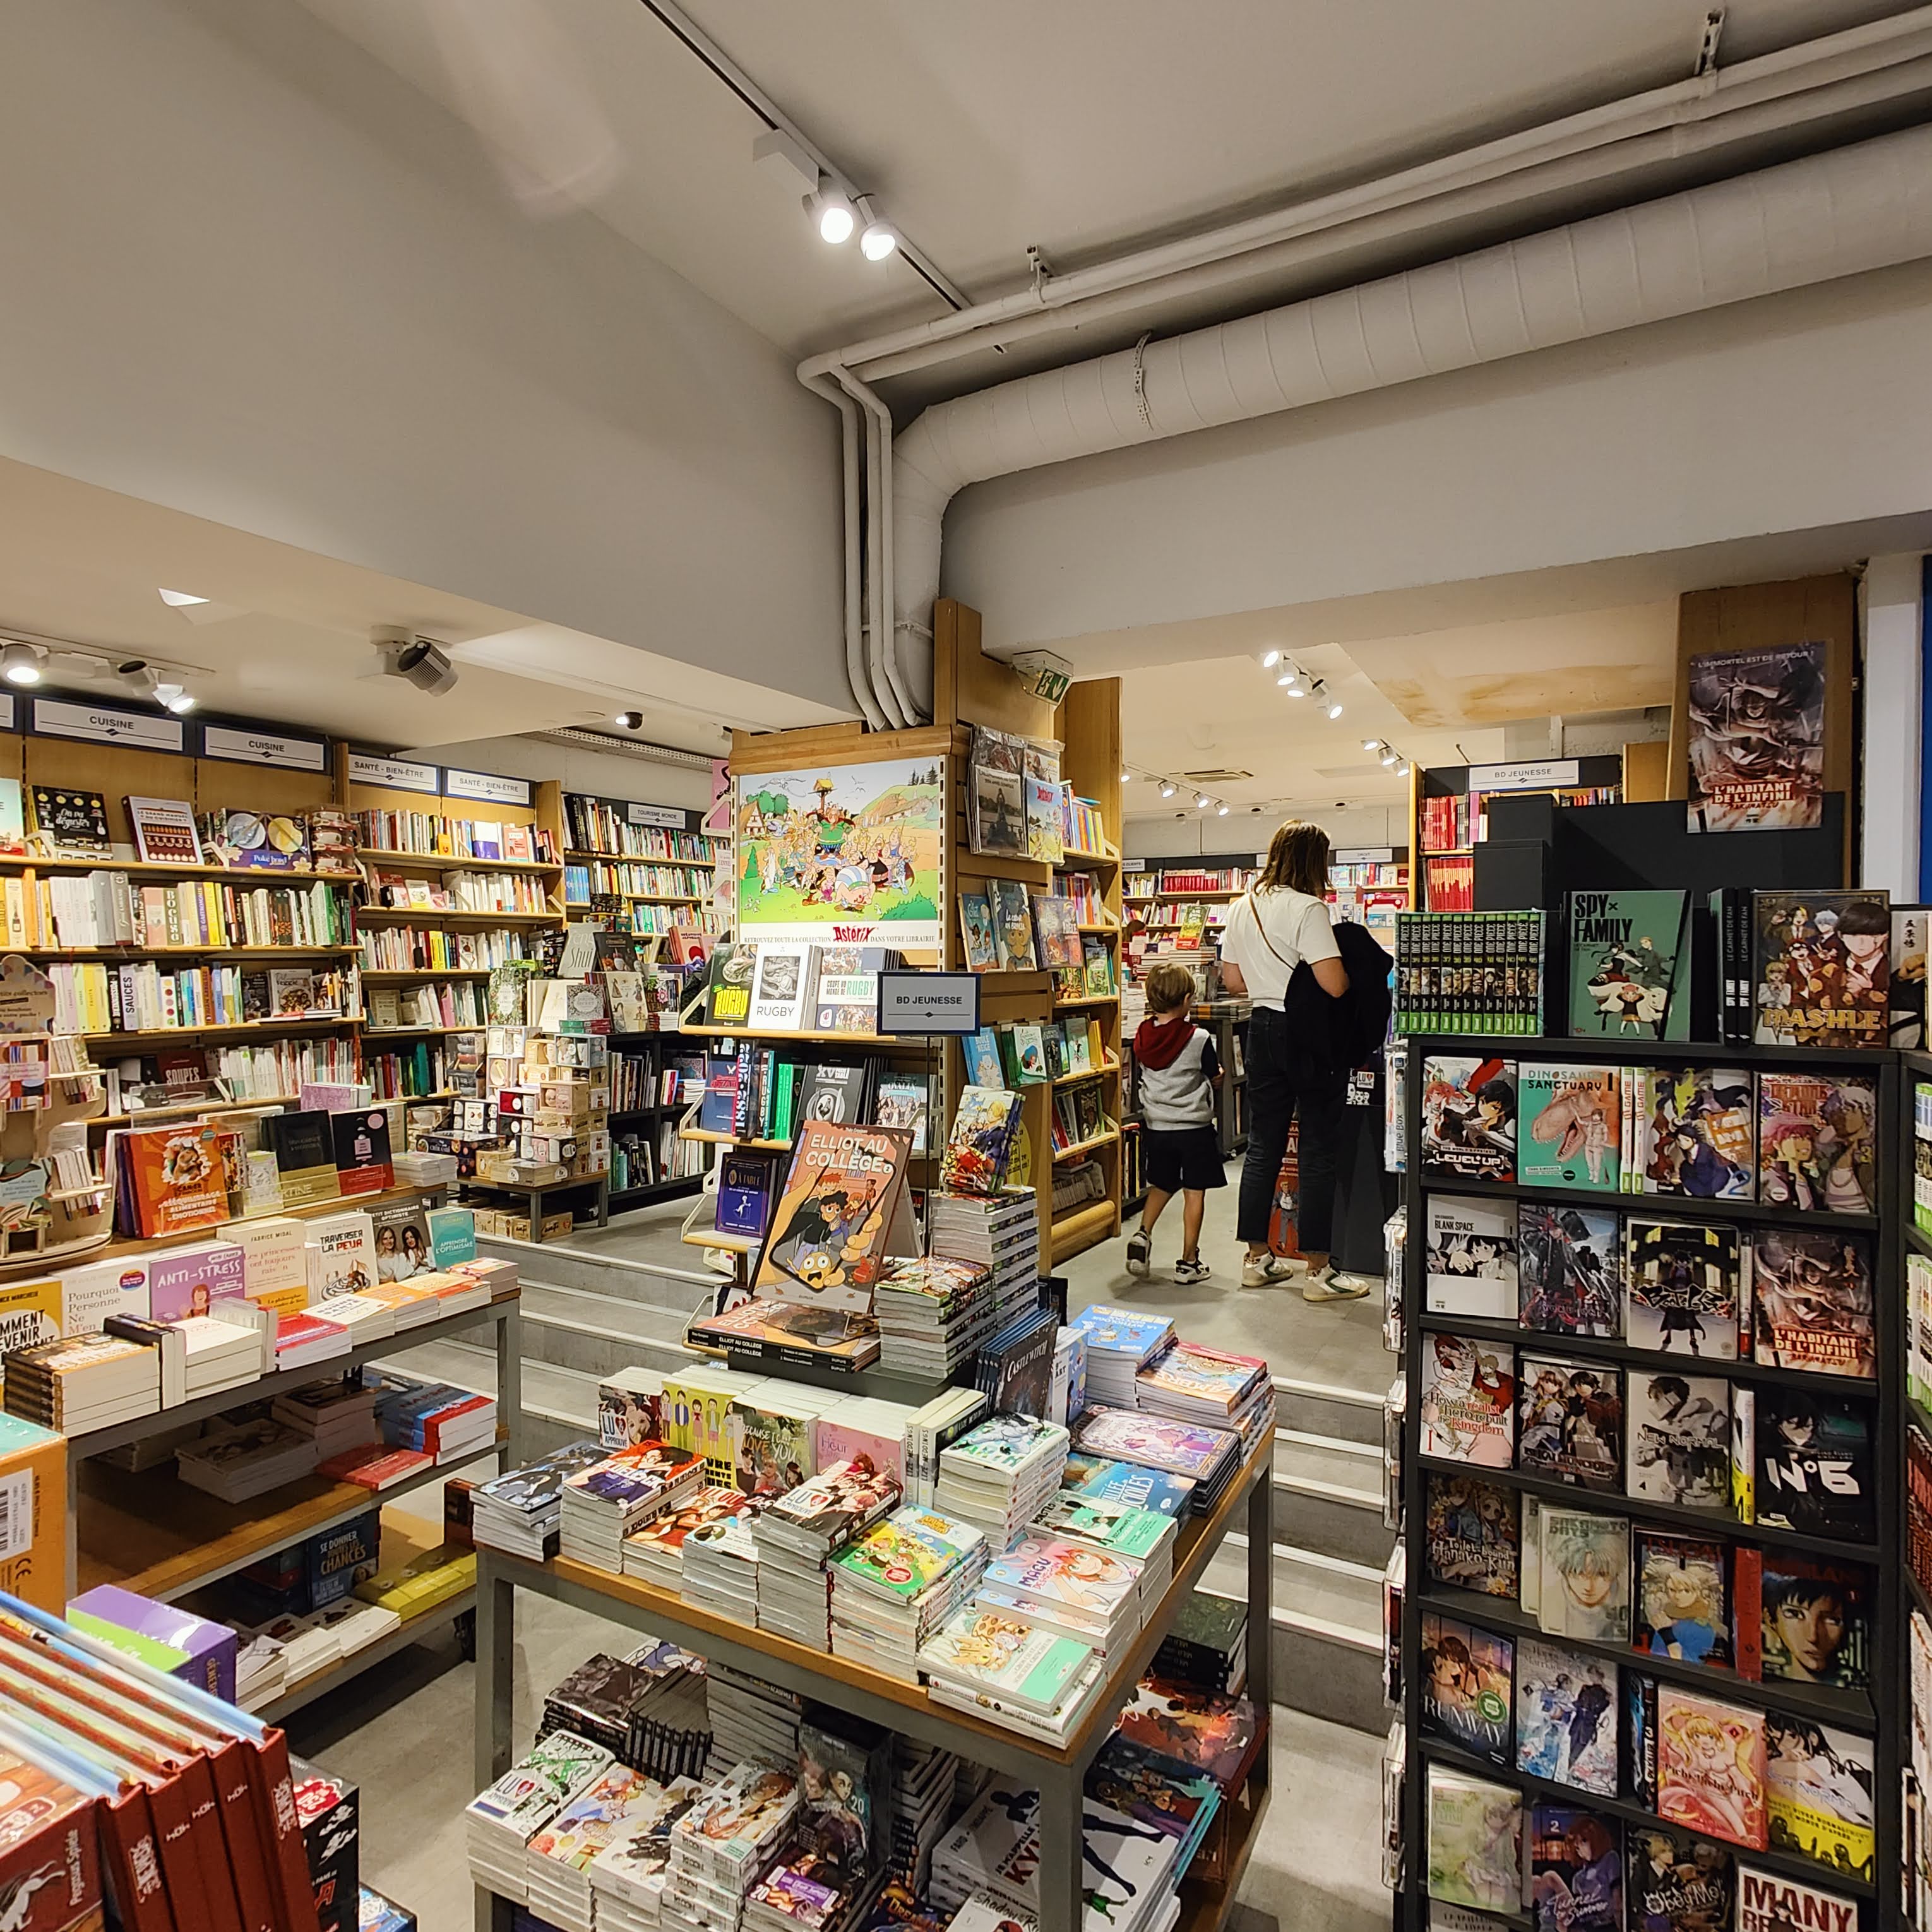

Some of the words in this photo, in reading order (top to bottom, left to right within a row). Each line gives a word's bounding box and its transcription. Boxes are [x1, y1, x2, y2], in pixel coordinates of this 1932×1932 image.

[89, 715, 135, 730] CUISINE
[248, 740, 285, 752] CUISINE
[354, 760, 381, 772] SANTÉ
[385, 766, 424, 778] BIEN-ÊTRE
[1508, 768, 1553, 777] JEUNESSE
[459, 777, 480, 787] SANTÉ
[486, 782, 519, 793] BIEN-ÊTRE
[1714, 782, 1792, 794] L'HABITANT
[1714, 794, 1731, 803] DE
[1734, 791, 1792, 802] L'INFINI
[636, 809, 660, 818] TOURISME
[661, 811, 677, 820] MONDE
[1575, 894, 1609, 919] SPY
[832, 926, 879, 943] Astérix
[1400, 924, 1409, 941] PIECE
[1422, 924, 1430, 941] PIECE
[1443, 924, 1452, 940] PIECE
[1464, 924, 1472, 941] PIECE
[1486, 924, 1495, 941] PIECE
[1507, 923, 1516, 940] PIECE
[1529, 924, 1539, 941] PIECE
[1575, 919, 1633, 943] FAMILY
[1400, 942, 1409, 953] ONE
[1422, 942, 1430, 953] ONE
[1443, 941, 1452, 952] ONE
[1464, 941, 1472, 953] ONE
[1486, 941, 1495, 953] ONE
[1507, 941, 1516, 952] ONE
[1529, 941, 1539, 953] ONE
[568, 947, 593, 969] Shui
[122, 977, 135, 1013] SAUCES
[847, 981, 876, 996] RUGBY
[713, 989, 749, 1017] RUGBY
[896, 996, 909, 1005] BD
[912, 996, 962, 1005] JEUNESSE
[756, 1006, 796, 1017] RUGBY
[1763, 1008, 1882, 1030] MASHLE
[1528, 1080, 1602, 1092] SANCTUARY
[1396, 1114, 1404, 1131] Box
[810, 1134, 864, 1151] ELLIOT
[864, 1138, 888, 1154] AU
[1396, 1132, 1405, 1152] Blue
[806, 1148, 885, 1173] COLLÈGE
[1483, 1157, 1501, 1166] UP
[1728, 1170, 1751, 1196] 2
[1434, 1219, 1455, 1231] BLANK
[1455, 1220, 1475, 1232] SPACE
[251, 1233, 273, 1243] FABRICE
[320, 1229, 363, 1245] TRAVERSER
[440, 1237, 468, 1247] APPRENDRE
[322, 1244, 334, 1253] LA
[336, 1239, 363, 1252] PEUR
[436, 1241, 474, 1255] L'OPTIMISME
[157, 1258, 242, 1289] ANTI-STRESS
[68, 1285, 119, 1303] Pourquoi
[68, 1297, 121, 1313] Personne
[0, 1309, 45, 1335] MMENT
[68, 1313, 85, 1325] Ne
[0, 1327, 40, 1350] EVENIR
[719, 1336, 735, 1345] ELLIOT
[1774, 1328, 1857, 1347] L'HABITANT
[719, 1344, 734, 1352] ELLIOT
[1774, 1340, 1792, 1351] DE
[1796, 1343, 1857, 1359] L'INFINI
[1006, 1339, 1049, 1383] CASTLEWITCH
[1054, 1364, 1067, 1379] ART
[1430, 1392, 1456, 1405] How
[1457, 1399, 1465, 1409] a
[1467, 1401, 1500, 1414] realist
[1444, 1404, 1472, 1419] hero
[1474, 1410, 1508, 1426] rebuilt
[602, 1415, 615, 1436] LU
[742, 1424, 770, 1440] BECAUSE
[1451, 1418, 1505, 1435] Kingdom
[605, 1435, 628, 1448] APPROUVÉ
[921, 1429, 929, 1463] MEDDINGS
[1637, 1428, 1666, 1445] NEW
[1669, 1433, 1726, 1450] NORMAL
[743, 1436, 770, 1453] LOVE
[772, 1443, 796, 1462] YOU
[785, 1488, 810, 1500] LU
[1549, 1517, 1628, 1531] SAKAMOTO
[1549, 1525, 1589, 1538] DAYS
[320, 1541, 328, 1553] SE
[328, 1531, 357, 1550] DONNER
[1446, 1537, 1509, 1560] Toilet-bound
[321, 1546, 366, 1575] CHANCES
[1431, 1539, 1516, 1571] Hanako-Kun
[1018, 1556, 1052, 1587] MAGU
[1424, 1695, 1501, 1746] RUNWAY
[496, 1774, 522, 1794] LU
[850, 1794, 865, 1815] 20
[1549, 1820, 1560, 1832] 2
[66, 1828, 82, 1864] Spiele
[69, 1861, 85, 1907] Pegasus
[750, 1885, 768, 1902] 20
[974, 1893, 1018, 1921] Shadow
[1743, 1875, 1853, 1931] MANY
